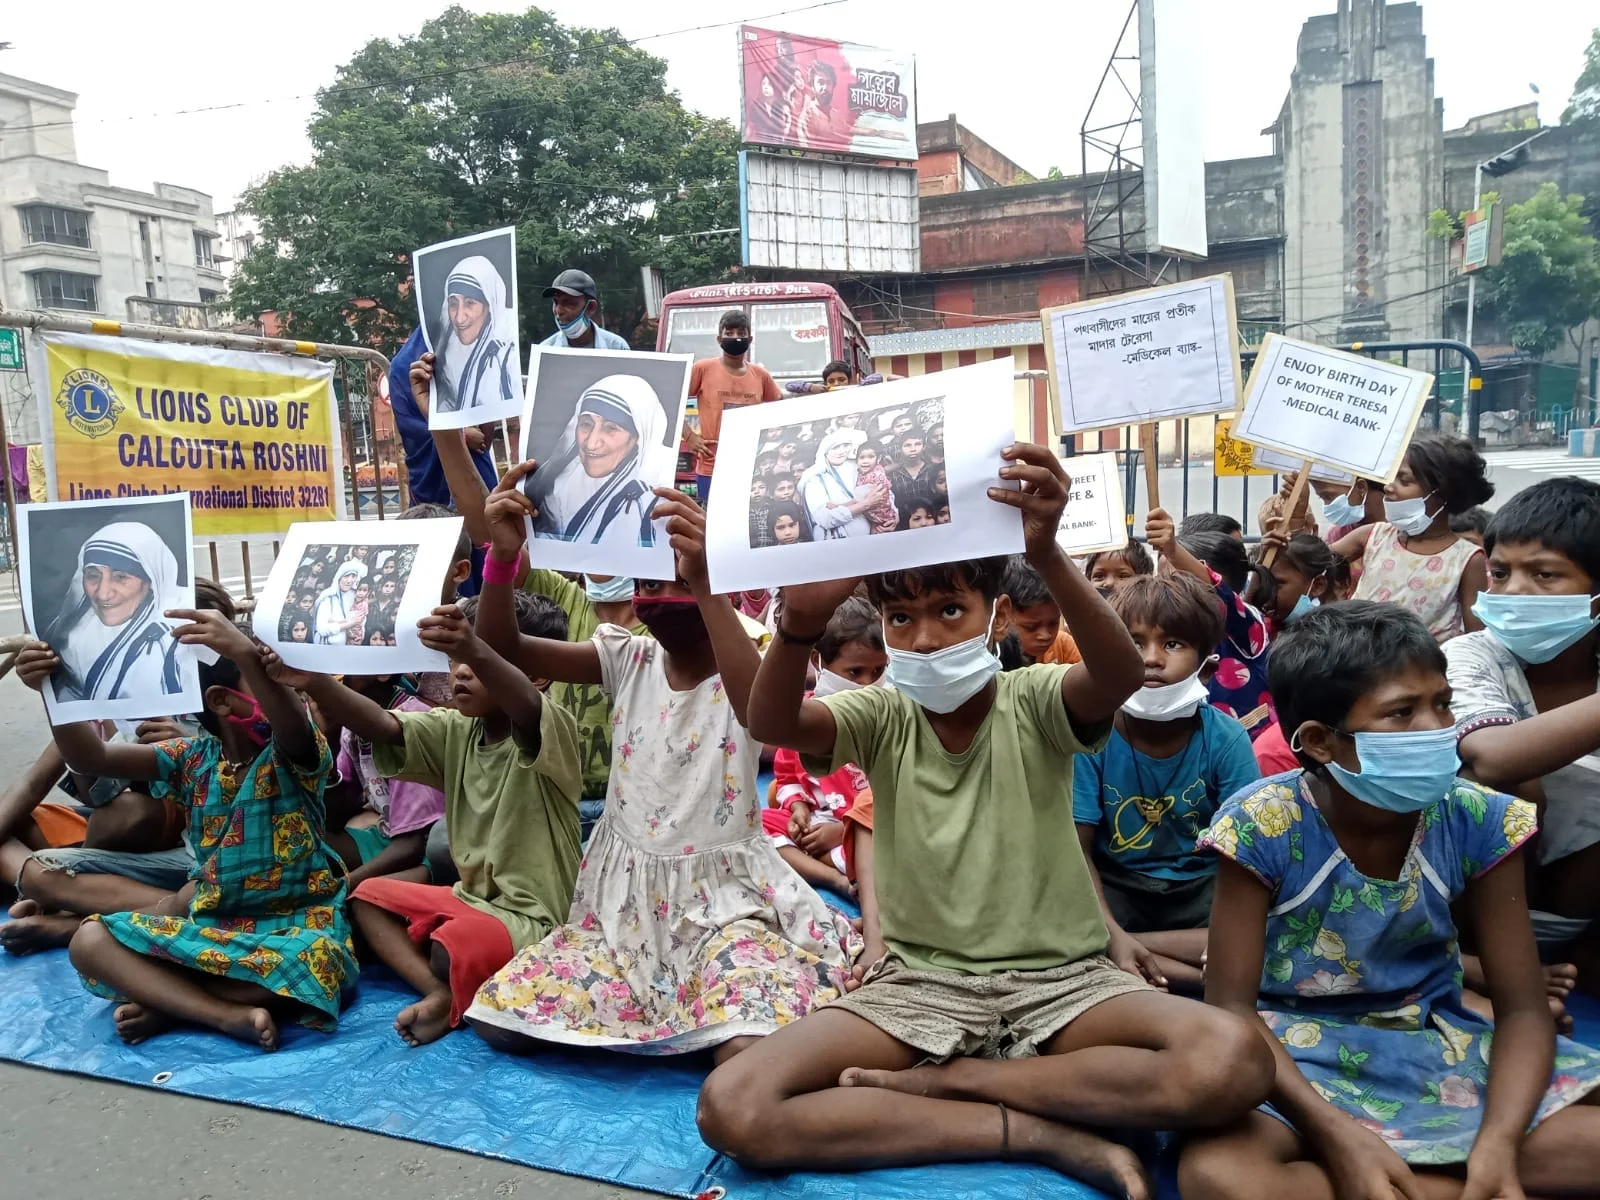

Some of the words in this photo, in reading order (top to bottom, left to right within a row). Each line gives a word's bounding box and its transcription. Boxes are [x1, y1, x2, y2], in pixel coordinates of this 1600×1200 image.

[858, 71, 896, 95] গল্পের
[850, 88, 903, 112] মায়াজাল
[1073, 317, 1127, 336] পথবাসীদের
[1131, 311, 1161, 325] মায়ের
[1166, 302, 1197, 319] প্রতীক
[1088, 338, 1116, 352] মাদার
[1121, 331, 1153, 347] টেরেসা
[69, 371, 107, 387] LIONS
[1283, 356, 1326, 377] ENJOY
[1326, 369, 1367, 389] BIRTH
[1368, 380, 1398, 397] DAY
[83, 389, 101, 414] L
[1276, 375, 1293, 387] OF
[1293, 380, 1344, 402] MOTHER
[1346, 394, 1388, 415] TERESA
[135, 387, 211, 424] LIONS
[219, 395, 279, 428] CLUB
[287, 401, 310, 430] OF
[1281, 396, 1340, 421] -MEDICAL
[1342, 413, 1382, 432] BANK-
[118, 433, 246, 470] CALCUTTA
[253, 441, 328, 473] ROSHNI
[1071, 474, 1097, 486] TREET
[252, 485, 296, 509] District
[298, 486, 330, 509] 322B1
[1085, 489, 1095, 500] &
